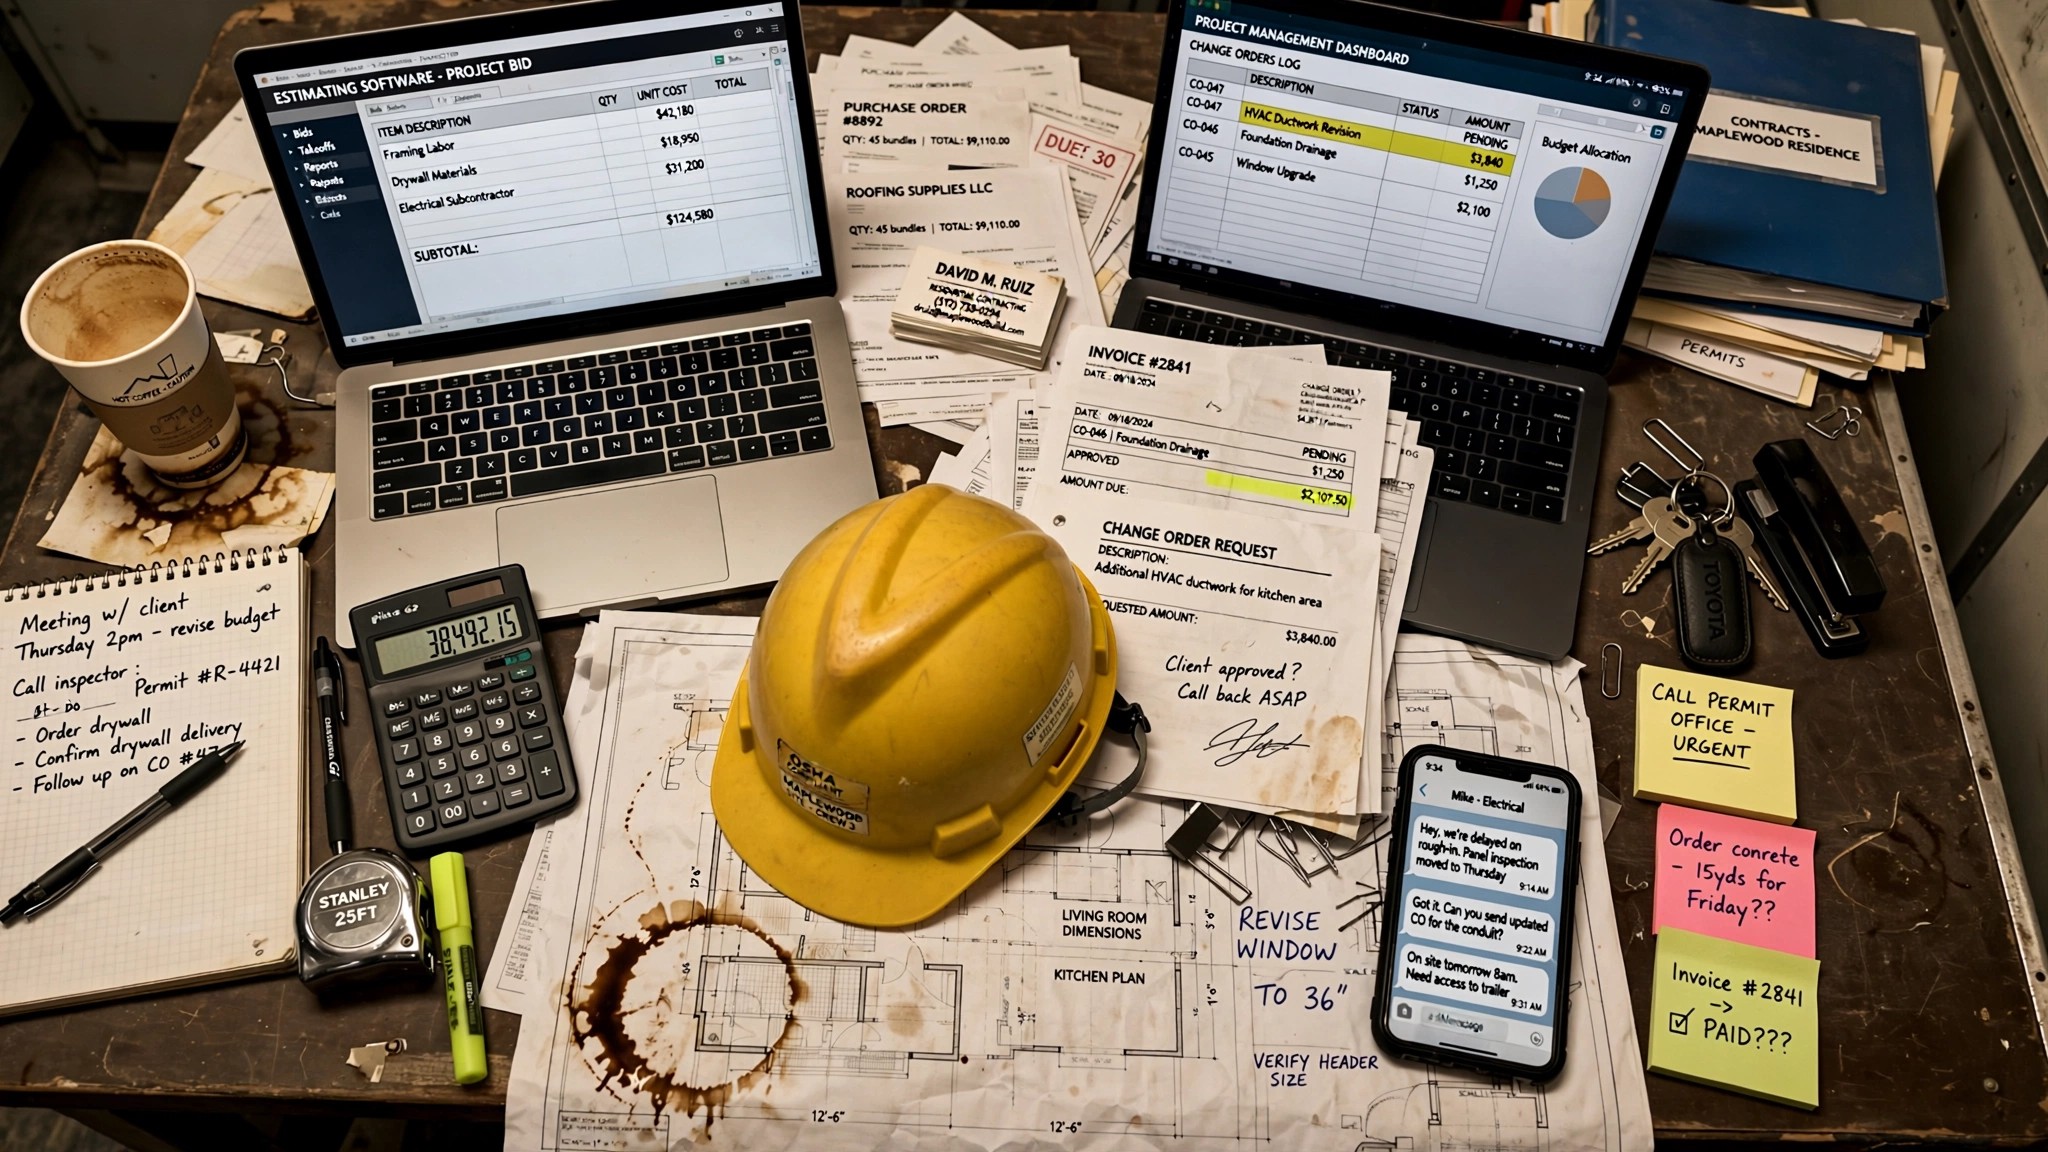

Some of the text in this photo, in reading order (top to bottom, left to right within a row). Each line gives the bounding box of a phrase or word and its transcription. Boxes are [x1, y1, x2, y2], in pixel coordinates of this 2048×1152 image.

[1195, 14, 1410, 66] PROJECT MANAGEMENT DASHBOARD
[1189, 39, 1301, 71] CHANGE ORDERS LOG
[273, 81, 358, 105] ESTIMATING
[361, 70, 435, 93] SOFTWARE
[446, 61, 505, 82] PROJECT
[508, 56, 532, 72] BID
[715, 76, 746, 90] TOTAL
[1189, 78, 1224, 95] CO-047
[1250, 73, 1314, 95] DESCRIPTION
[598, 95, 617, 107] QTY
[637, 84, 688, 101] UNIT COST
[1186, 96, 1222, 112] CO-047
[656, 104, 694, 120] $42,180
[843, 102, 967, 114] PURCHASE ORDER
[1402, 103, 1439, 120] STATUS
[293, 127, 313, 139] Bids
[377, 115, 471, 138] ITEM DESCRIPTION
[843, 116, 883, 127] #8892
[1183, 118, 1219, 135] CO-046
[1244, 105, 1361, 140] HVAC Ductwork Revision
[1465, 115, 1511, 133] AMOUNT
[1730, 116, 1811, 138] CONTRACTS
[384, 141, 455, 160] Framing Labor
[660, 132, 699, 149] $18,950
[843, 134, 1010, 147] QTY: 45 bundles TOTAL: $9,110.00
[1240, 129, 1337, 161] Foundation Drainage
[1541, 136, 1632, 164] Budget Allocation
[1694, 125, 1861, 162] MAPLEWOOD RESIDENCE
[1178, 146, 1214, 163] CO-045
[1470, 151, 1503, 169] $3,840
[303, 160, 339, 175] Reports
[392, 164, 477, 189] Drywall Materials
[665, 158, 705, 175] $31,200
[1237, 157, 1316, 183] Window Upgrade
[846, 182, 993, 199] ROOFING SUPPLIES LLC
[1464, 174, 1498, 191] $1,250
[399, 188, 515, 214] Electrical Subcontractor
[1456, 201, 1491, 219] $2,100
[666, 208, 714, 226] $124,580
[414, 243, 479, 262] SUBTOTAL:
[935, 261, 1035, 296] DAVID M. RUIZ
[1088, 345, 1191, 375] INVOICE #2841
[1681, 338, 1746, 369] PERMITS
[1067, 449, 1120, 466] APPROVED
[1060, 475, 1129, 495] AMOUNT DUE:
[1102, 520, 1277, 560] CHANGE ORDER REQUEST
[1098, 544, 1170, 565] DESCRIPTION:
[1094, 562, 1322, 609] Additional HVAC ductwork for kitchen area
[1703, 560, 1728, 642] TOYOTA
[20, 592, 189, 636] Meeting w/ client
[15, 602, 281, 660] Thursday 2pm revise budget
[425, 608, 518, 660] 38,492.15
[1285, 630, 1337, 648] $3,840.00
[135, 655, 281, 697] Permit #R-4421
[1165, 654, 1286, 682] Client approved
[12, 676, 46, 697] Call
[1177, 683, 1307, 708] Call back ASAP
[1651, 682, 1775, 719] CALL PERMIT
[35, 724, 82, 744] Order
[89, 707, 151, 739] drywall
[1670, 712, 1735, 735] OFFICE
[35, 722, 243, 769] Confirm drywall delivery
[1673, 735, 1751, 761] URGENT
[33, 757, 170, 794] Follow up on CO
[790, 753, 836, 786] OSHA
[1451, 789, 1525, 814] Mike Electrical
[1420, 822, 1522, 851] Hey, we're delayed on
[1669, 827, 1800, 868] Order conrete
[1418, 840, 1539, 871] rough-in. Panel inspection
[1416, 855, 1507, 884] moved to Thursday
[1696, 863, 1787, 893] 15yds for
[319, 881, 390, 910] STANLEY
[334, 905, 378, 928] 25FT
[1062, 908, 1147, 925] LIVING ROOM
[1239, 906, 1321, 932] REVISE
[1687, 890, 1776, 927] Friday??
[1062, 925, 1142, 940] DIMENSIONS
[1237, 939, 1338, 961] WINDOW
[1054, 969, 1145, 985] KITCHEN PLAN
[1672, 962, 1803, 1008] Invoice #2841
[1254, 983, 1287, 1006] TO
[1703, 1018, 1792, 1055] PAID???
[1253, 1053, 1379, 1070] VERIFY HEADER
[1270, 1072, 1308, 1087] SIZE
